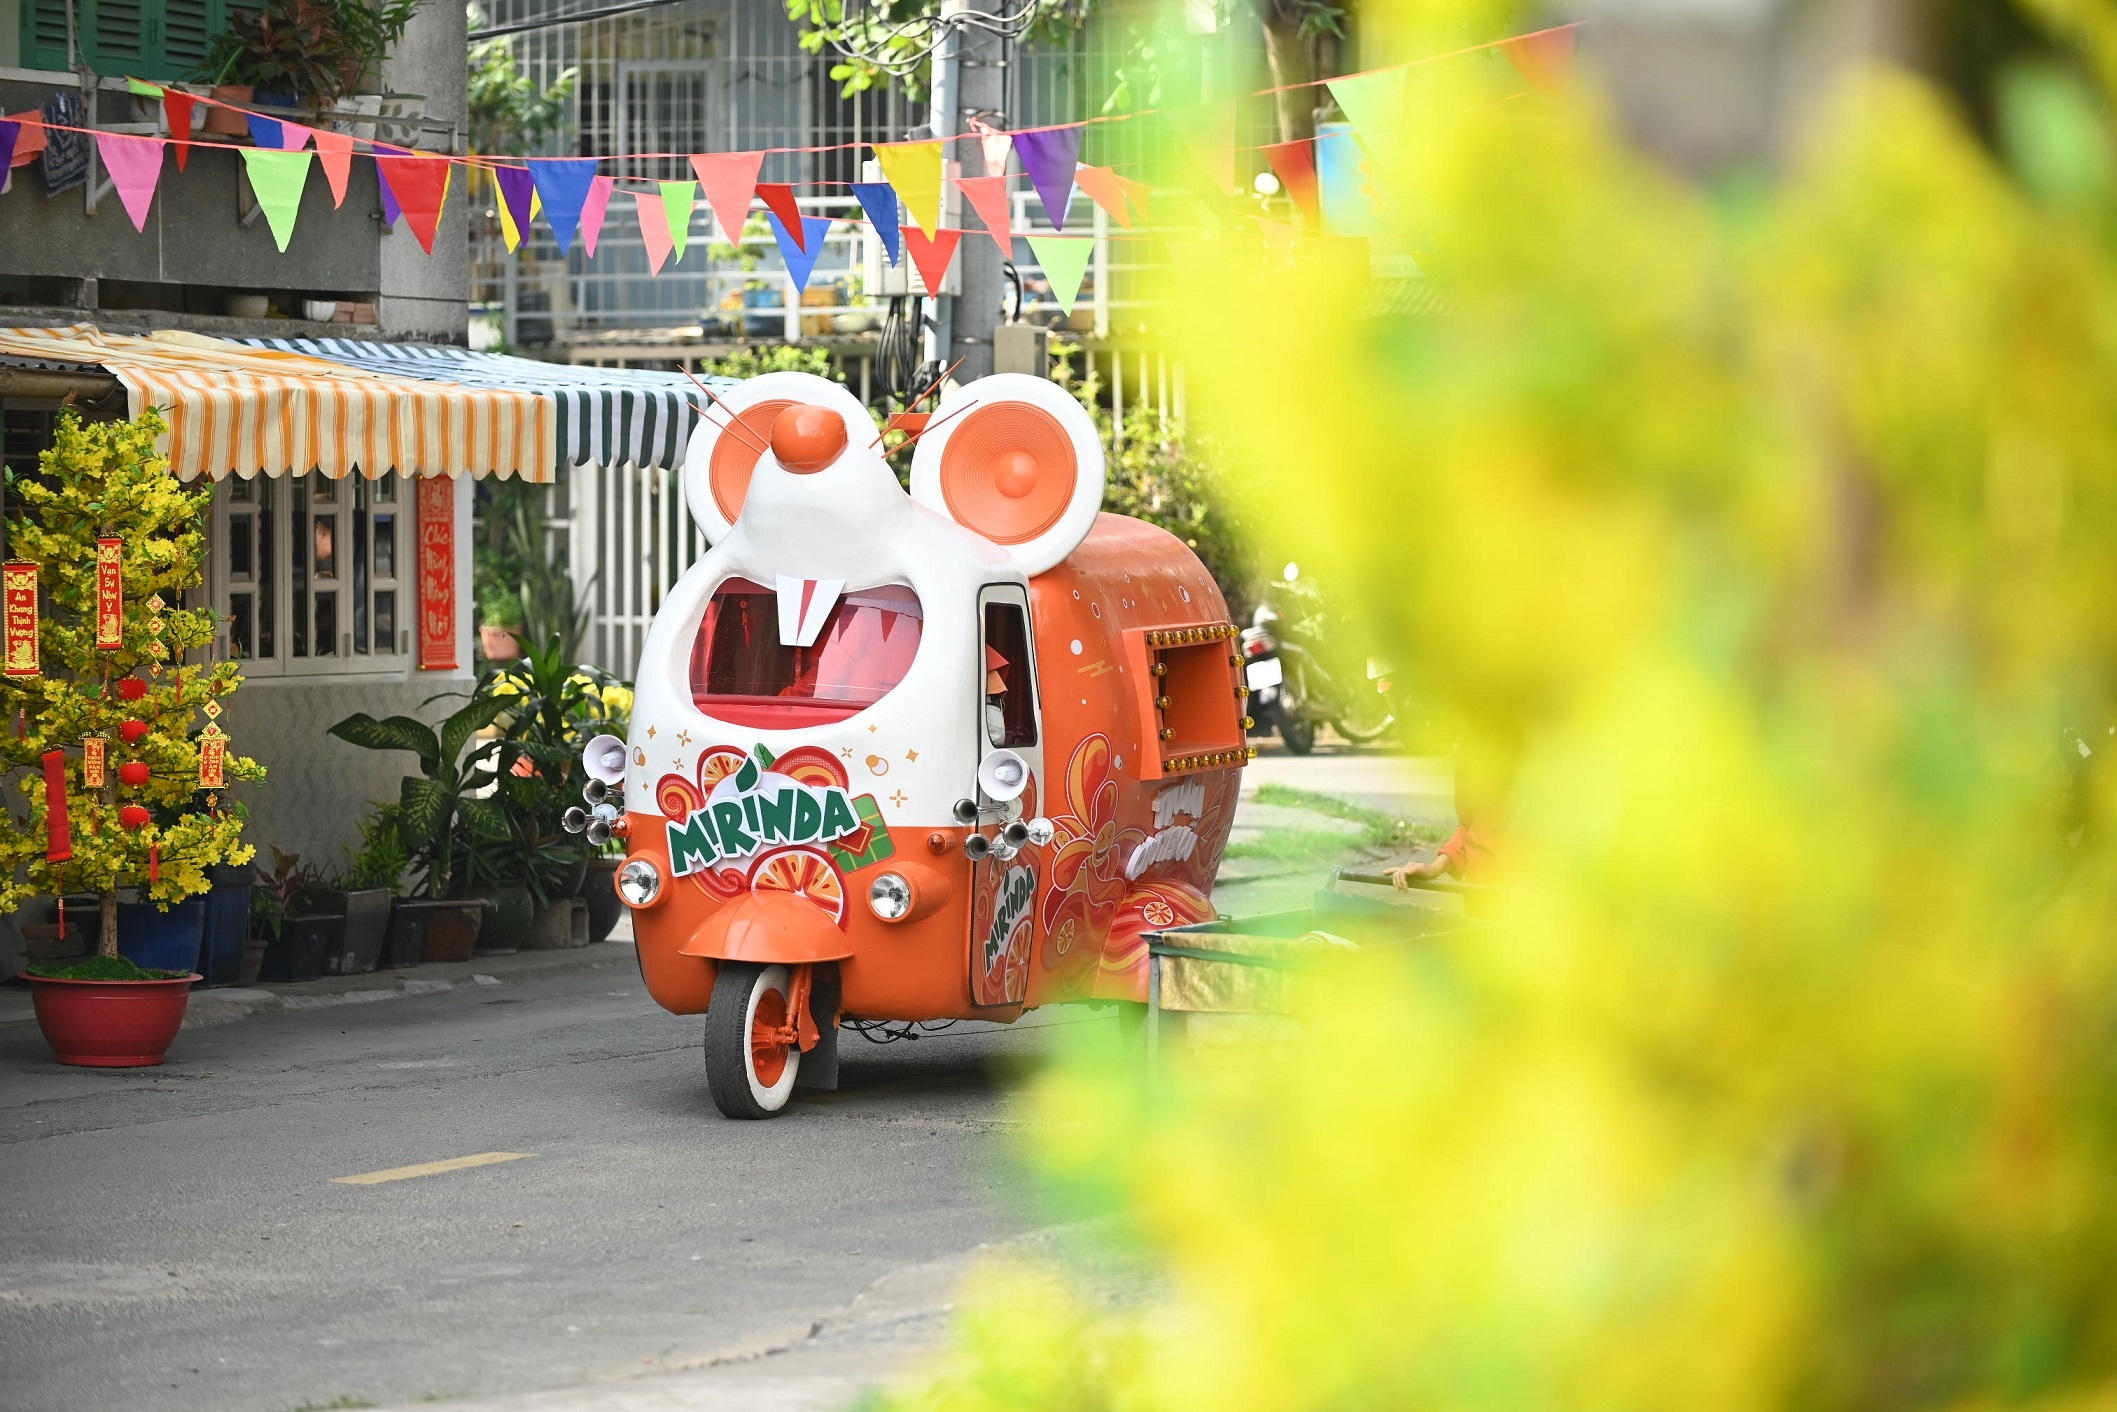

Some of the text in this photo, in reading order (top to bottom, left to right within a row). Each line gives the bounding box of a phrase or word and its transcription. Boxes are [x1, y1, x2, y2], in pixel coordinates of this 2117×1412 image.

[425, 524, 449, 545] Chúc
[101, 565, 117, 576] Vạn
[15, 592, 27, 601] An
[102, 589, 117, 600] Như
[9, 604, 33, 614] Khang
[12, 616, 31, 626] Thịnh
[10, 627, 34, 638] Vượng
[668, 757, 857, 874] MIRINDA
[985, 866, 1034, 975] MIRINDA
